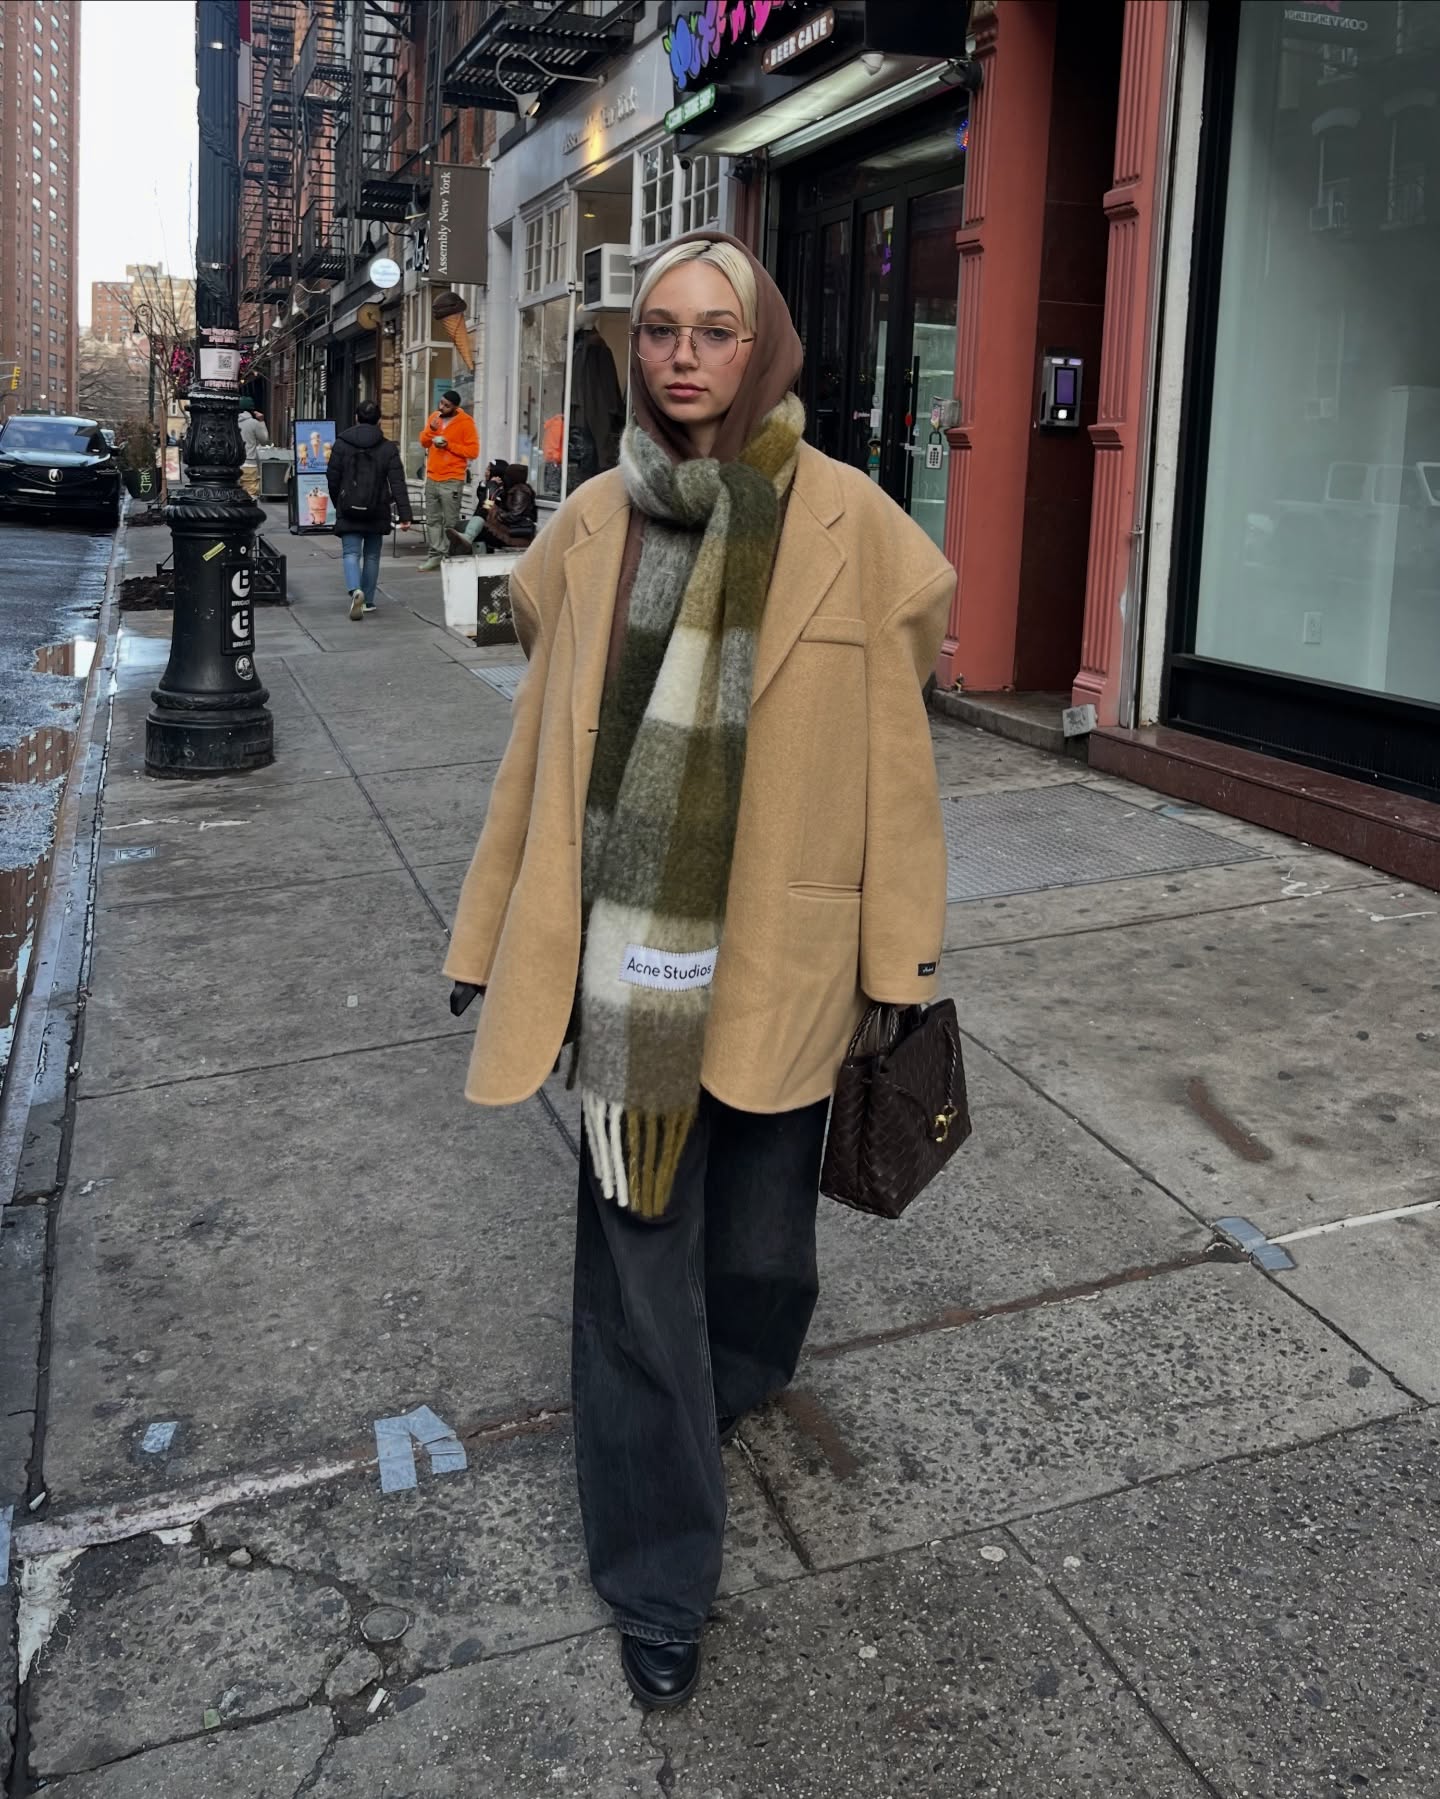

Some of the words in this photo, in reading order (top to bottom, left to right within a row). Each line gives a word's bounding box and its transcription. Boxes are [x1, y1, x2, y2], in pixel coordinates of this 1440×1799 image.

[770, 37, 796, 66] BEER
[797, 16, 828, 50] CAVE
[440, 171, 452, 196] York
[438, 199, 450, 222] New
[438, 224, 452, 275] Assembly
[626, 956, 661, 977] Acne
[663, 964, 712, 980] Studios
